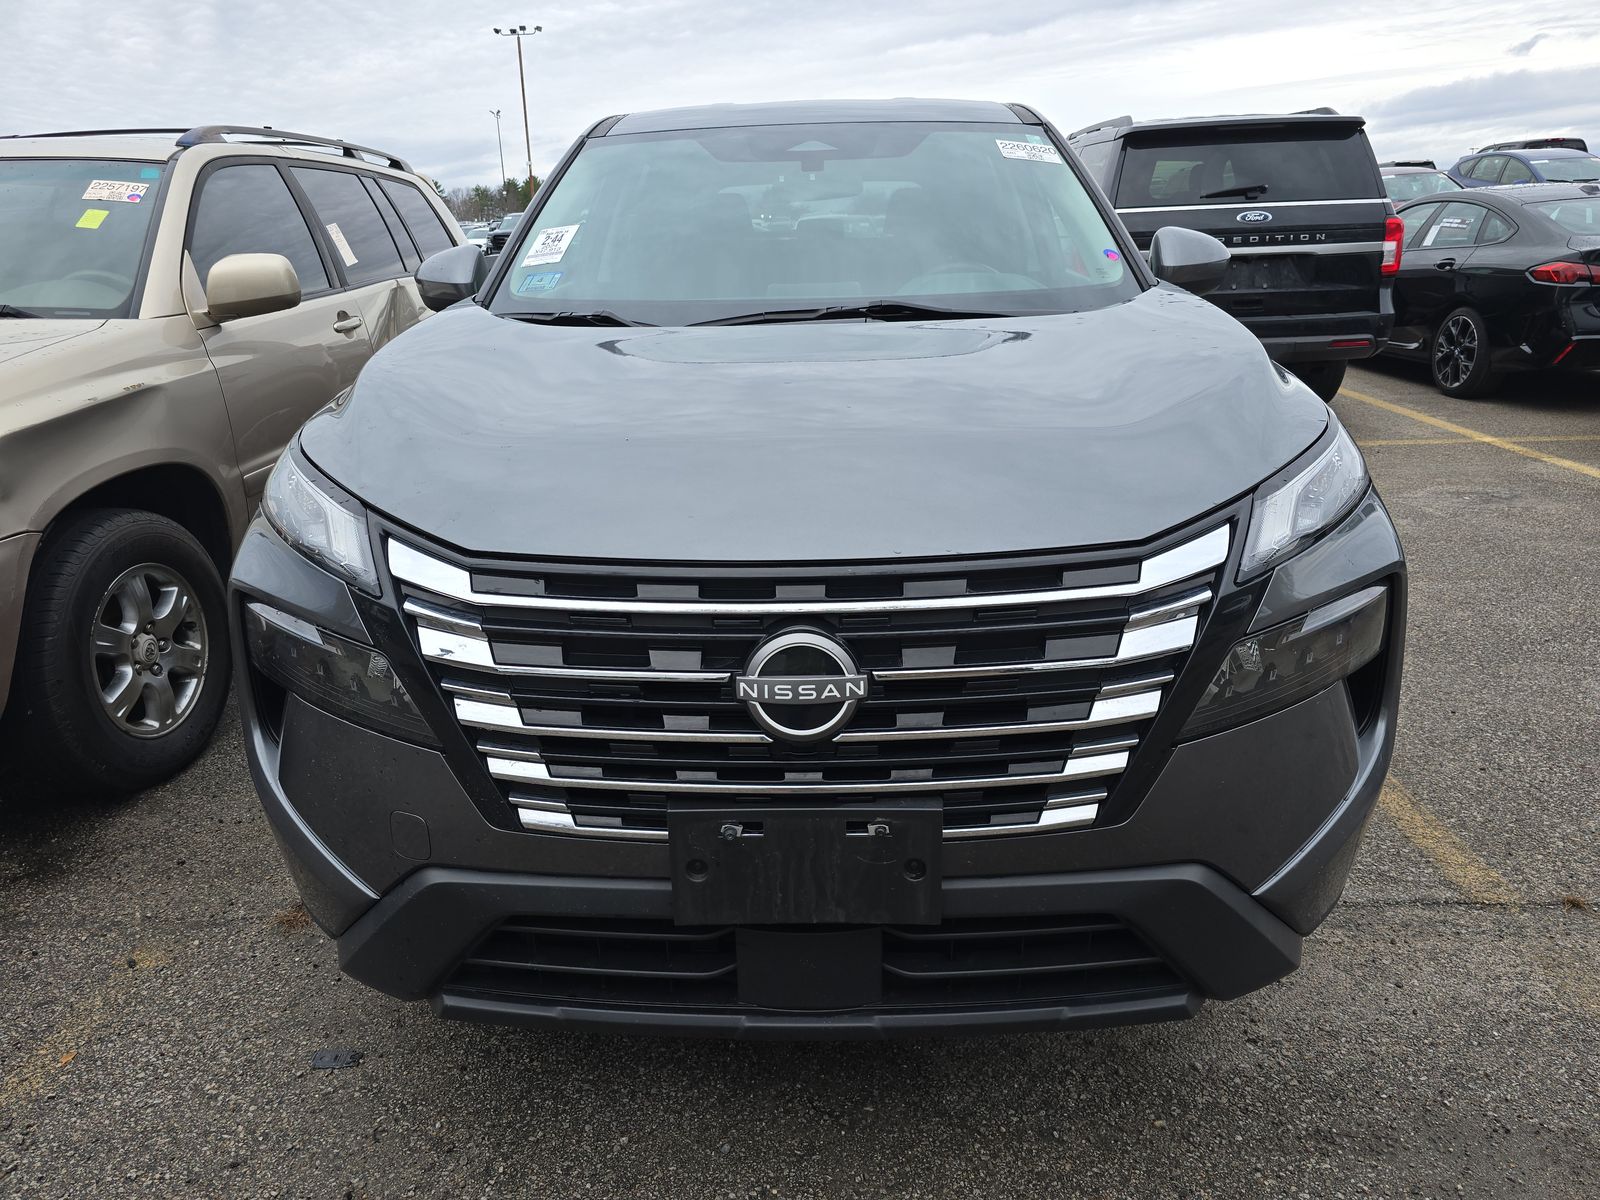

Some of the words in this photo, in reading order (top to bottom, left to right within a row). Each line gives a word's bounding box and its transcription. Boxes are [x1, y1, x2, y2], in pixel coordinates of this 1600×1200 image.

[1000, 142, 1057, 155] 2260620
[91, 182, 147, 193] 2257197
[740, 680, 864, 700] NISSAN
